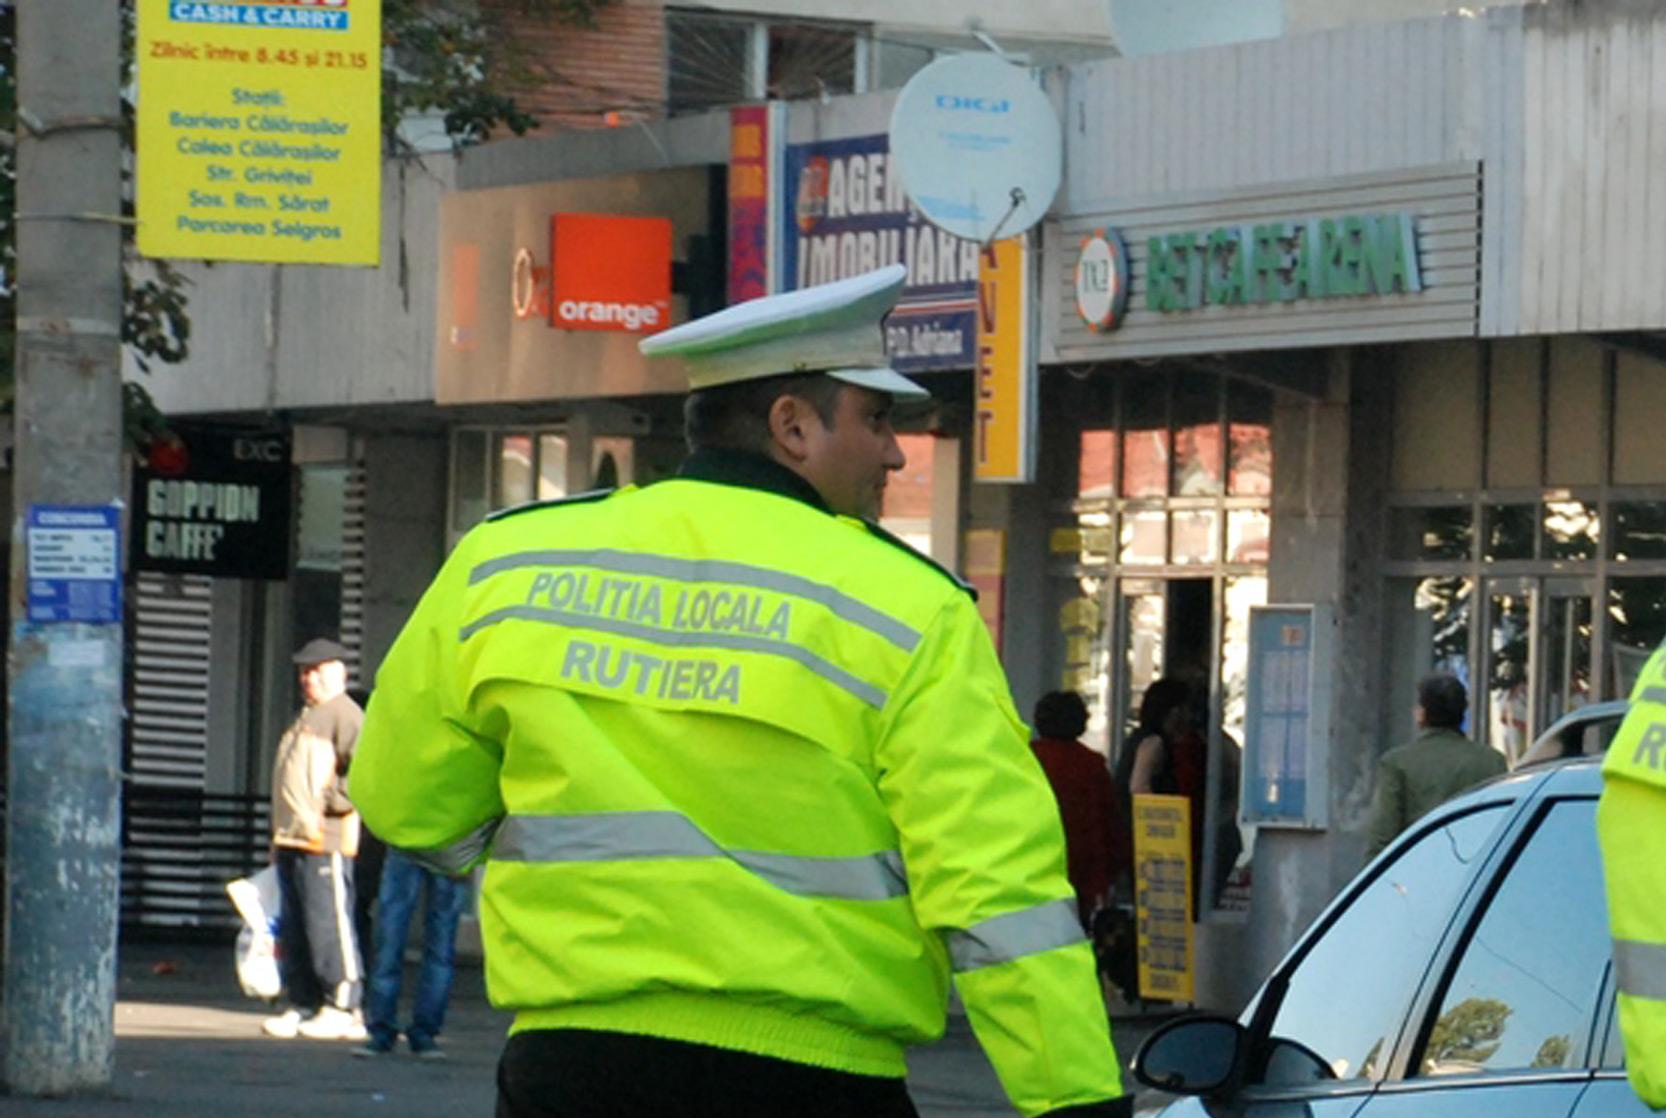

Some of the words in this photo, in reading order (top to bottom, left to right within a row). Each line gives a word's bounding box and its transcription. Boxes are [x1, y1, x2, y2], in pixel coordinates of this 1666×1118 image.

[173, 3, 238, 21] CASH
[243, 6, 259, 22] &
[263, 8, 342, 28] CARRY
[936, 95, 1011, 113] DIGI
[177, 137, 233, 156] Calea
[177, 215, 265, 235] Parcarea
[272, 219, 342, 240] Selgros
[559, 300, 658, 330] orange
[526, 571, 663, 626] POLITIA
[672, 589, 791, 642] LOCALA
[560, 640, 742, 705] RUTIERA
